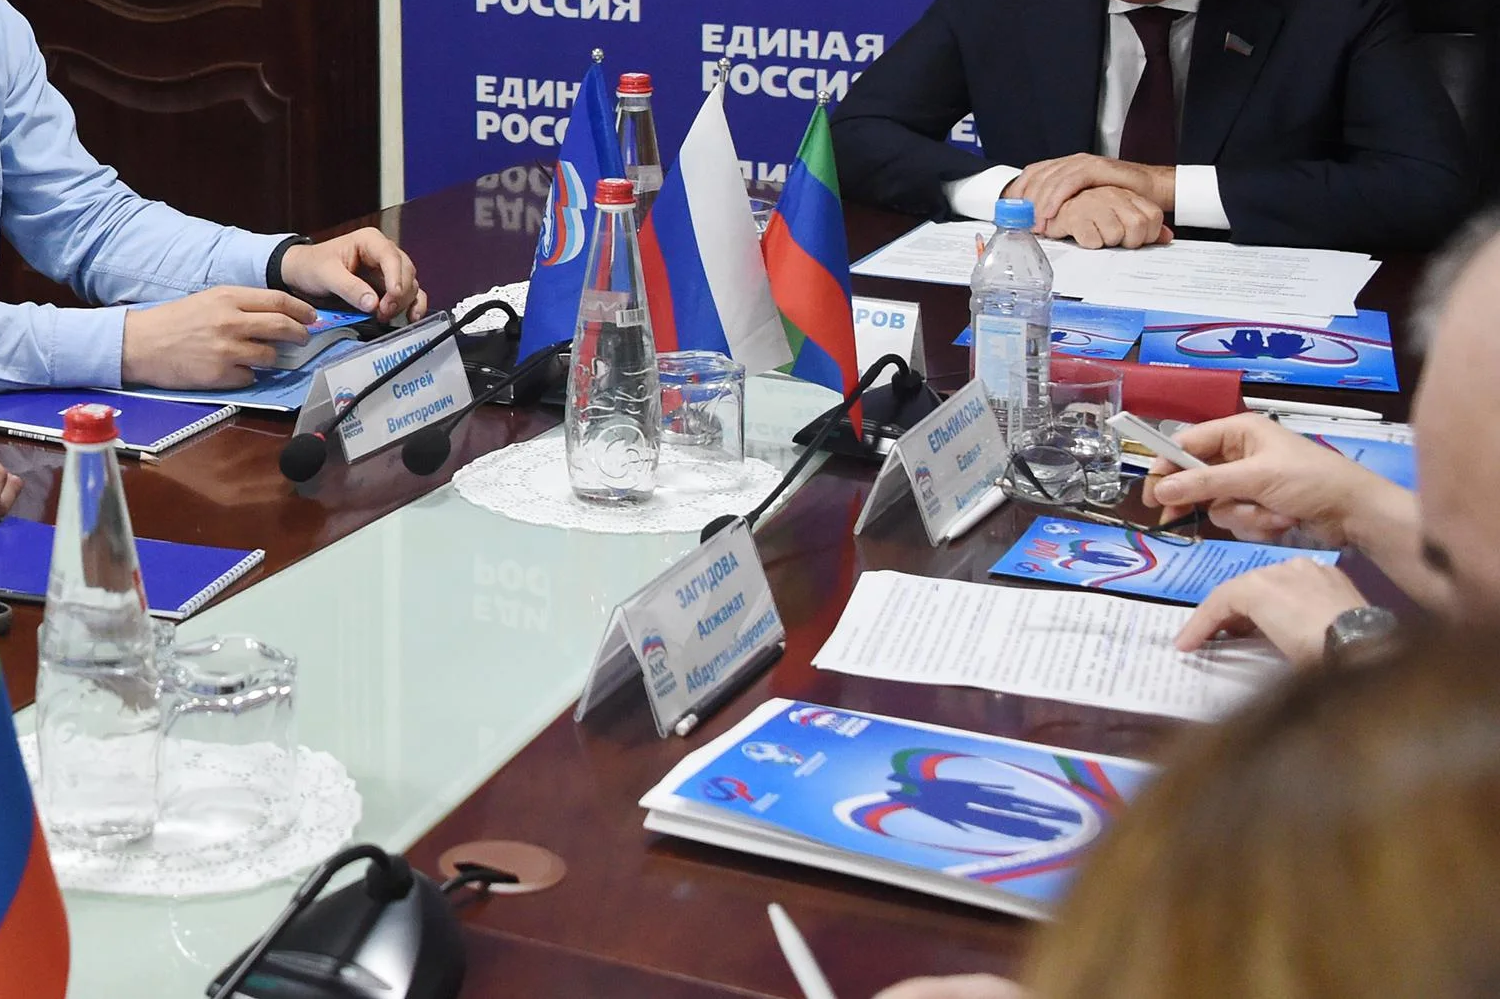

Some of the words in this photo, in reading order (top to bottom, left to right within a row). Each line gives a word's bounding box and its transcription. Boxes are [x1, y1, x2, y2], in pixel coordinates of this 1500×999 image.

[702, 23, 884, 62] ЕДИНАЯ
[476, 75, 583, 109] ЕДИН
[702, 60, 863, 103] РОССИ
[855, 308, 905, 329] РОВ
[372, 338, 435, 377] НИКИТИ
[392, 369, 435, 399] Сергей
[386, 394, 455, 434] Викторович
[927, 397, 986, 454] ЕЛЬНИКОВА
[675, 551, 739, 609] ЗАГИДОВА
[697, 591, 746, 641] Алжанат
